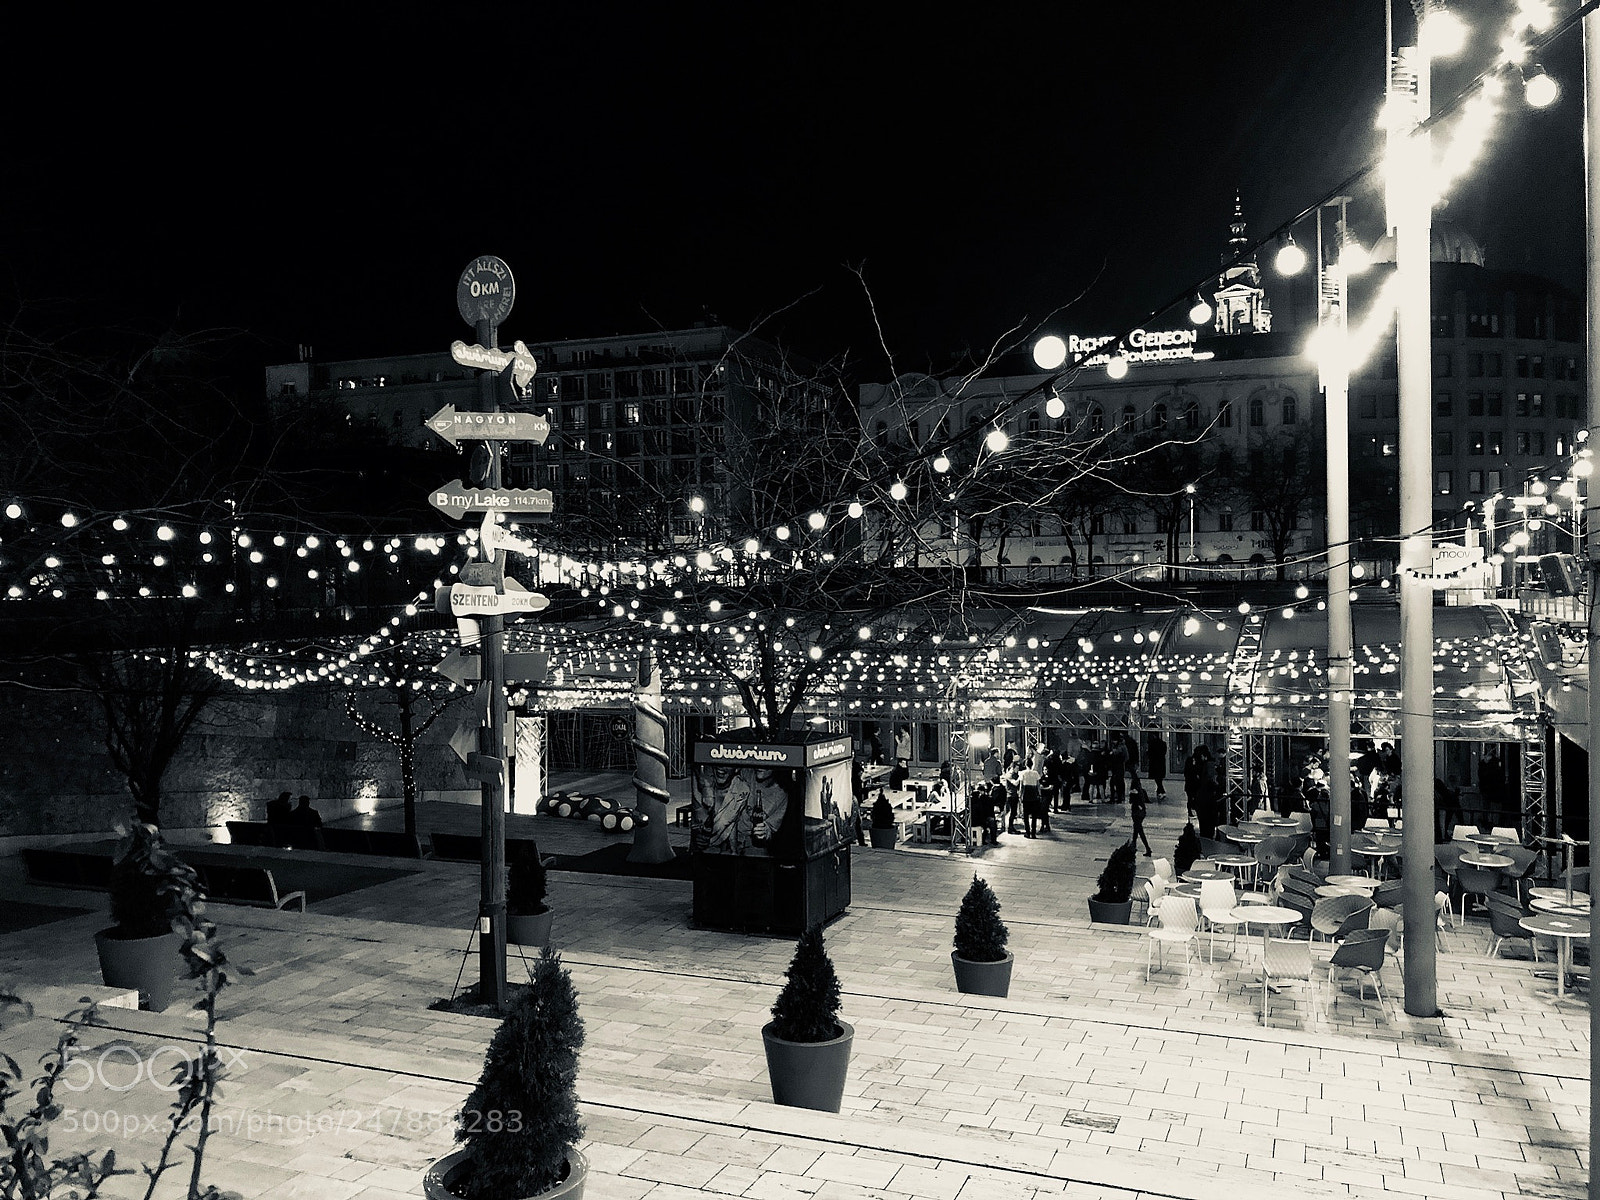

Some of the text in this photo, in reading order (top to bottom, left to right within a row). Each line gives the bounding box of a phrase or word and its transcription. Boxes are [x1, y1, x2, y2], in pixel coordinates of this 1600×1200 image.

[454, 415, 516, 424] NAGYON
[533, 423, 548, 431] KM
[436, 492, 449, 506] B
[451, 495, 473, 509] my
[474, 493, 510, 507] Lake
